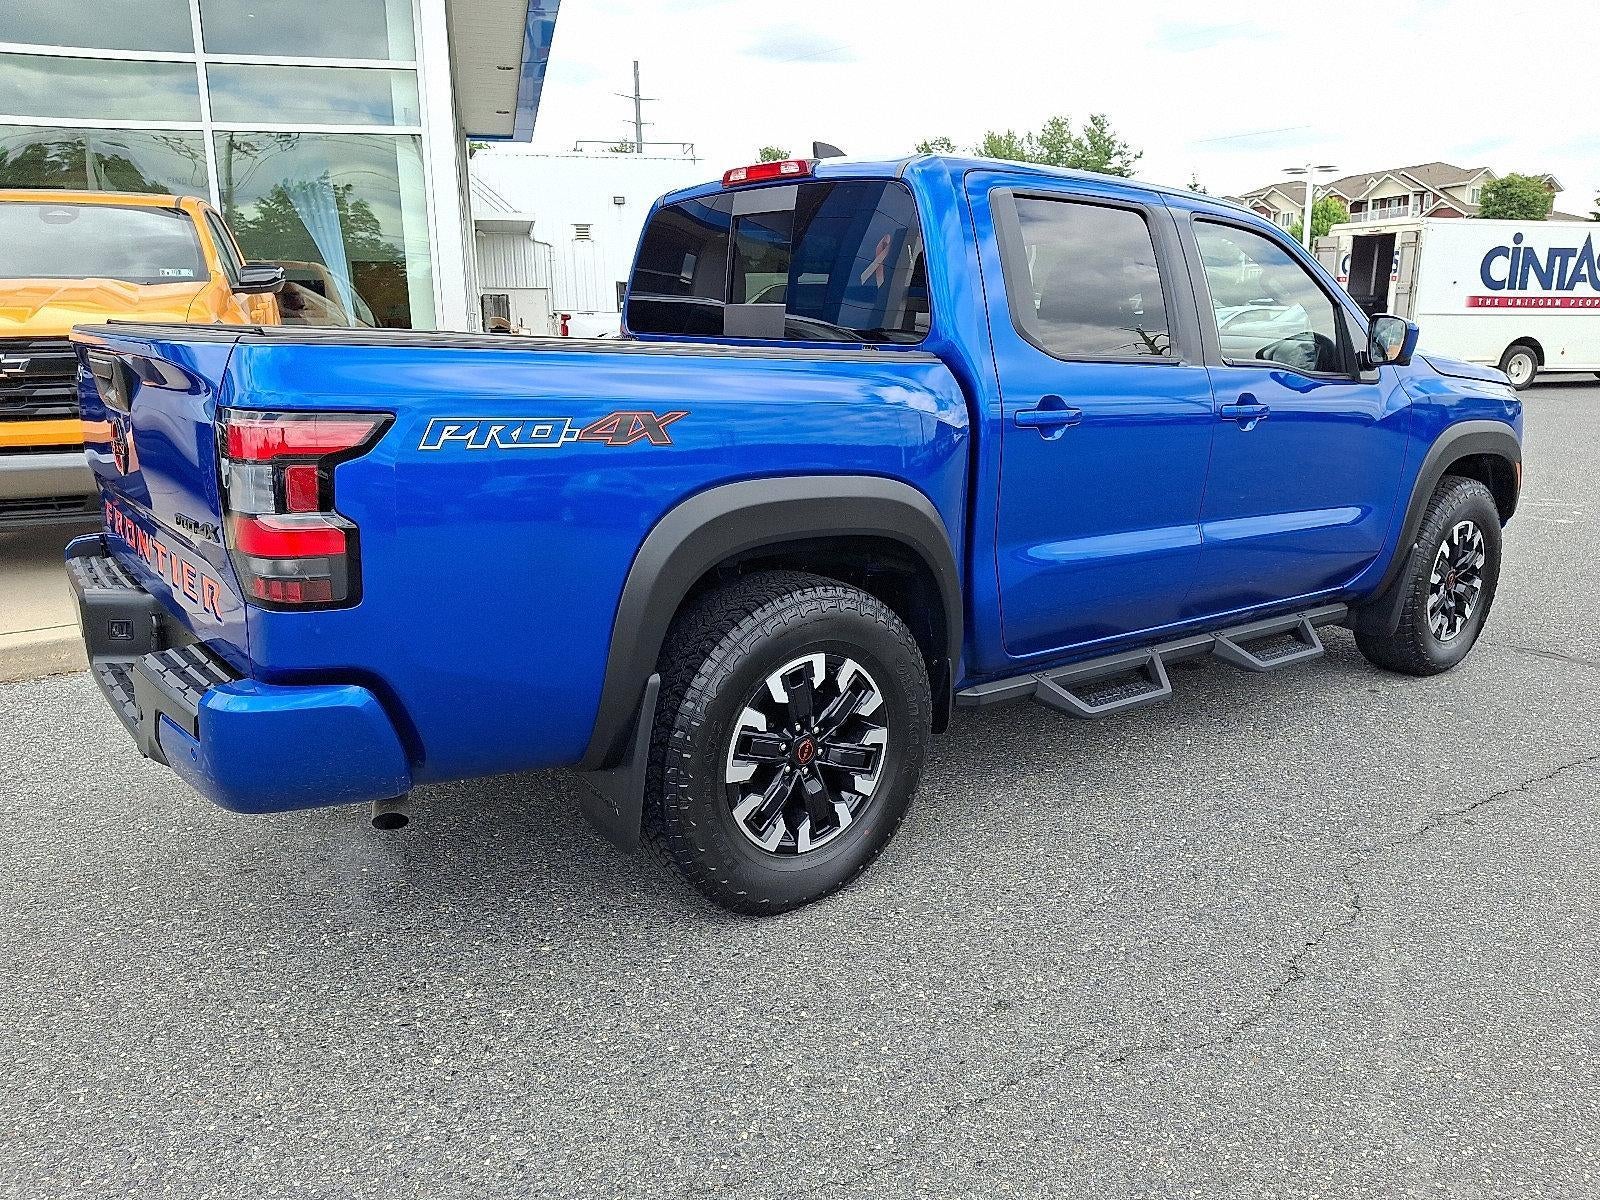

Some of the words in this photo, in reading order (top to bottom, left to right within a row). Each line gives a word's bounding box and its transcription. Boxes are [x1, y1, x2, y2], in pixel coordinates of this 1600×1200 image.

[1480, 231, 1600, 291] CiNTA
[1478, 298, 1499, 306] THE
[1507, 298, 1561, 306] UNIFORM
[104, 499, 224, 626] FRONTIER
